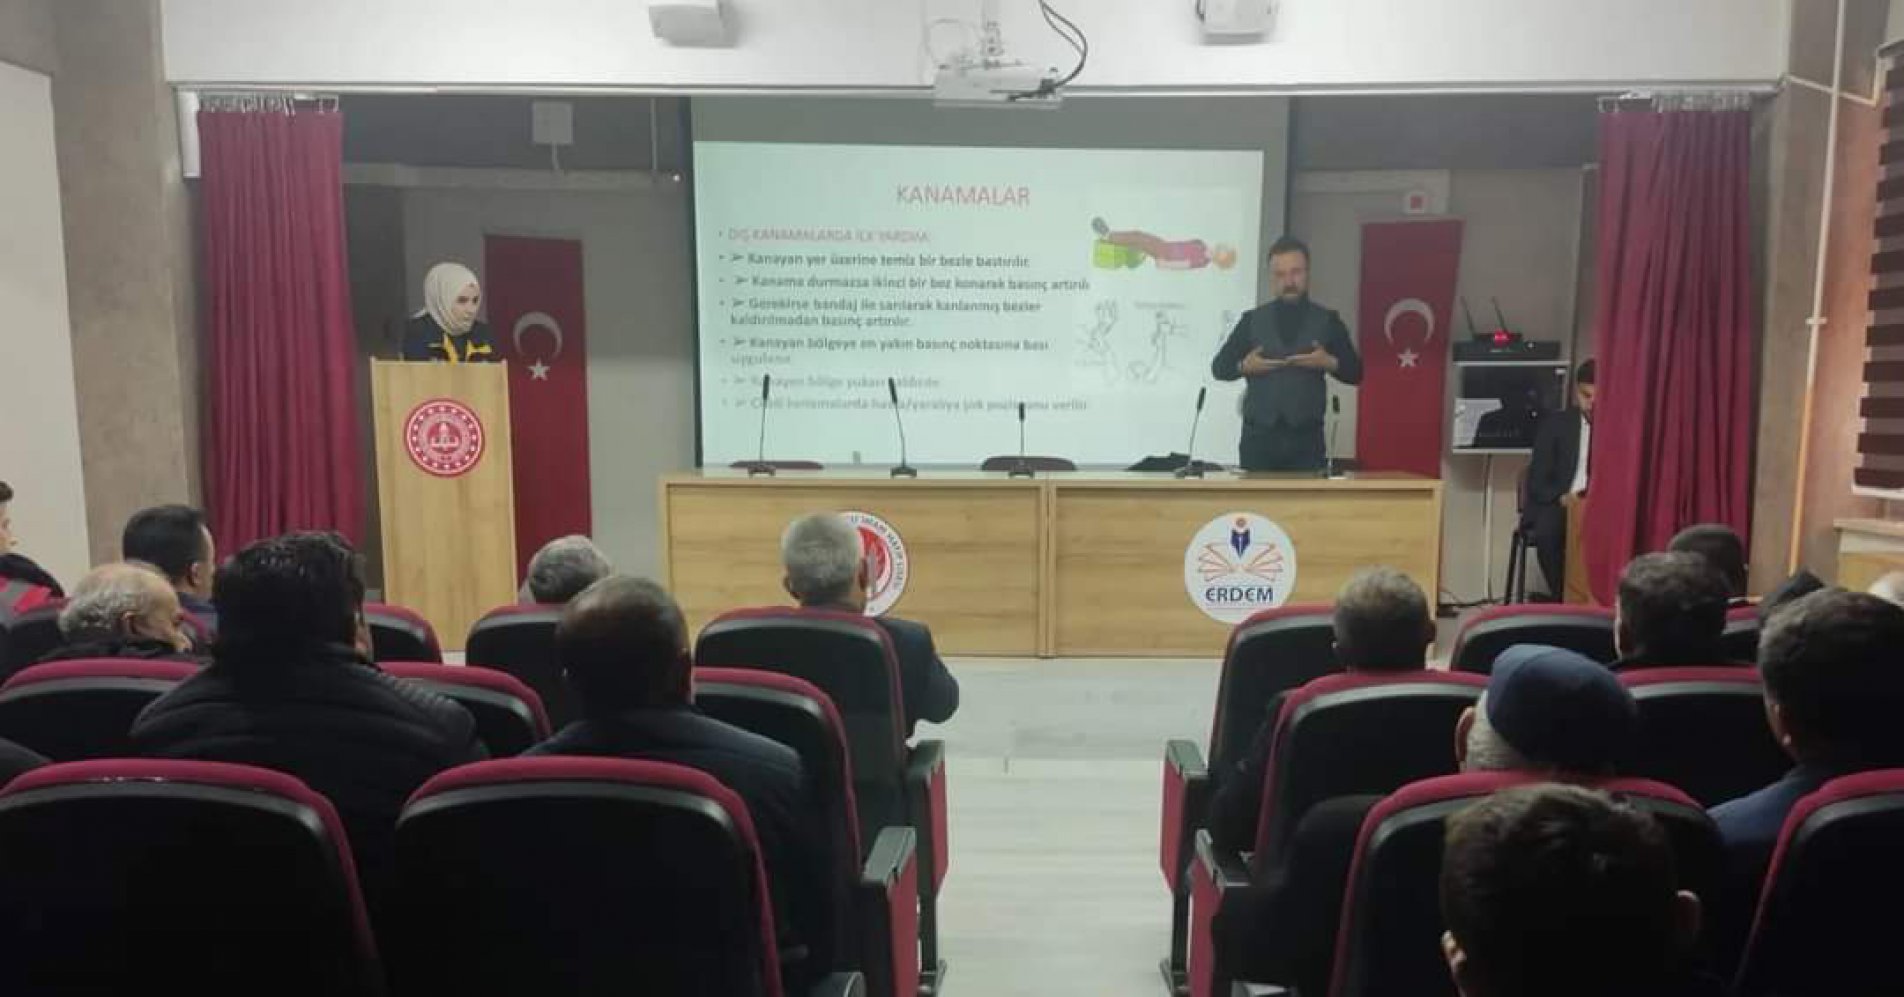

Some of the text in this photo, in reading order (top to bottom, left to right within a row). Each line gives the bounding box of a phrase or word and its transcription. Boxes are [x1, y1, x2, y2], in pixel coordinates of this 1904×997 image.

[897, 185, 1030, 206] KANAMALAR
[748, 253, 802, 268] Kanayan
[806, 255, 827, 268] yer
[831, 253, 878, 266] üzerine
[881, 254, 915, 267] temiz
[920, 253, 936, 267] bir
[940, 253, 973, 267] bezle
[752, 275, 804, 288] Kanama
[909, 276, 926, 289] bir
[749, 297, 809, 310] Gerekirse
[813, 297, 857, 312] bandaj
[916, 338, 956, 352] basınç
[1205, 586, 1274, 602] ERDEM
